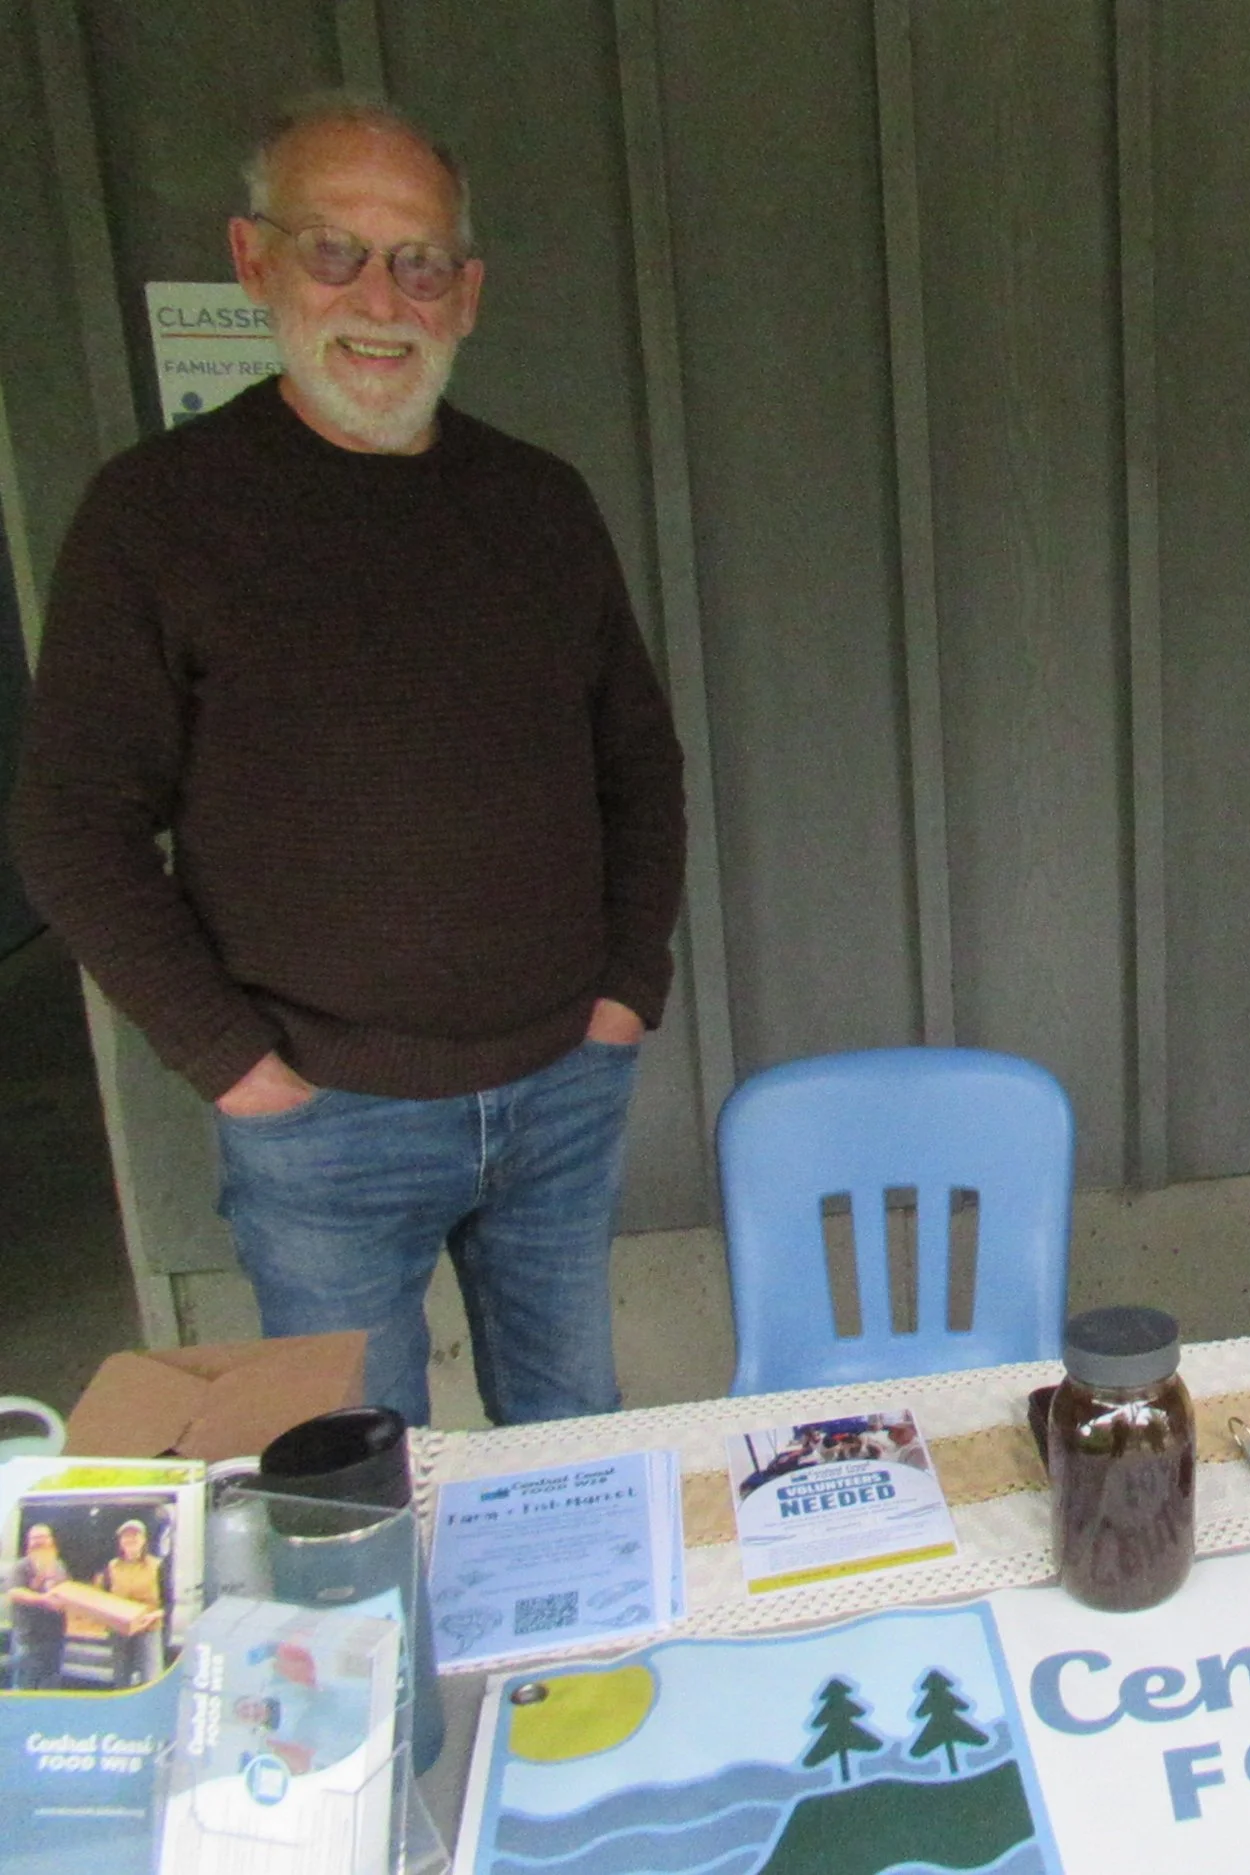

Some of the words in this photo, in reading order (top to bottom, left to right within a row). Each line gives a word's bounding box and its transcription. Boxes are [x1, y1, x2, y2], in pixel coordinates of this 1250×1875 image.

[164, 360, 235, 375] FAMILY
[785, 1472, 882, 1497] VOLUNTEERS
[780, 1484, 896, 1518] NEEDED
